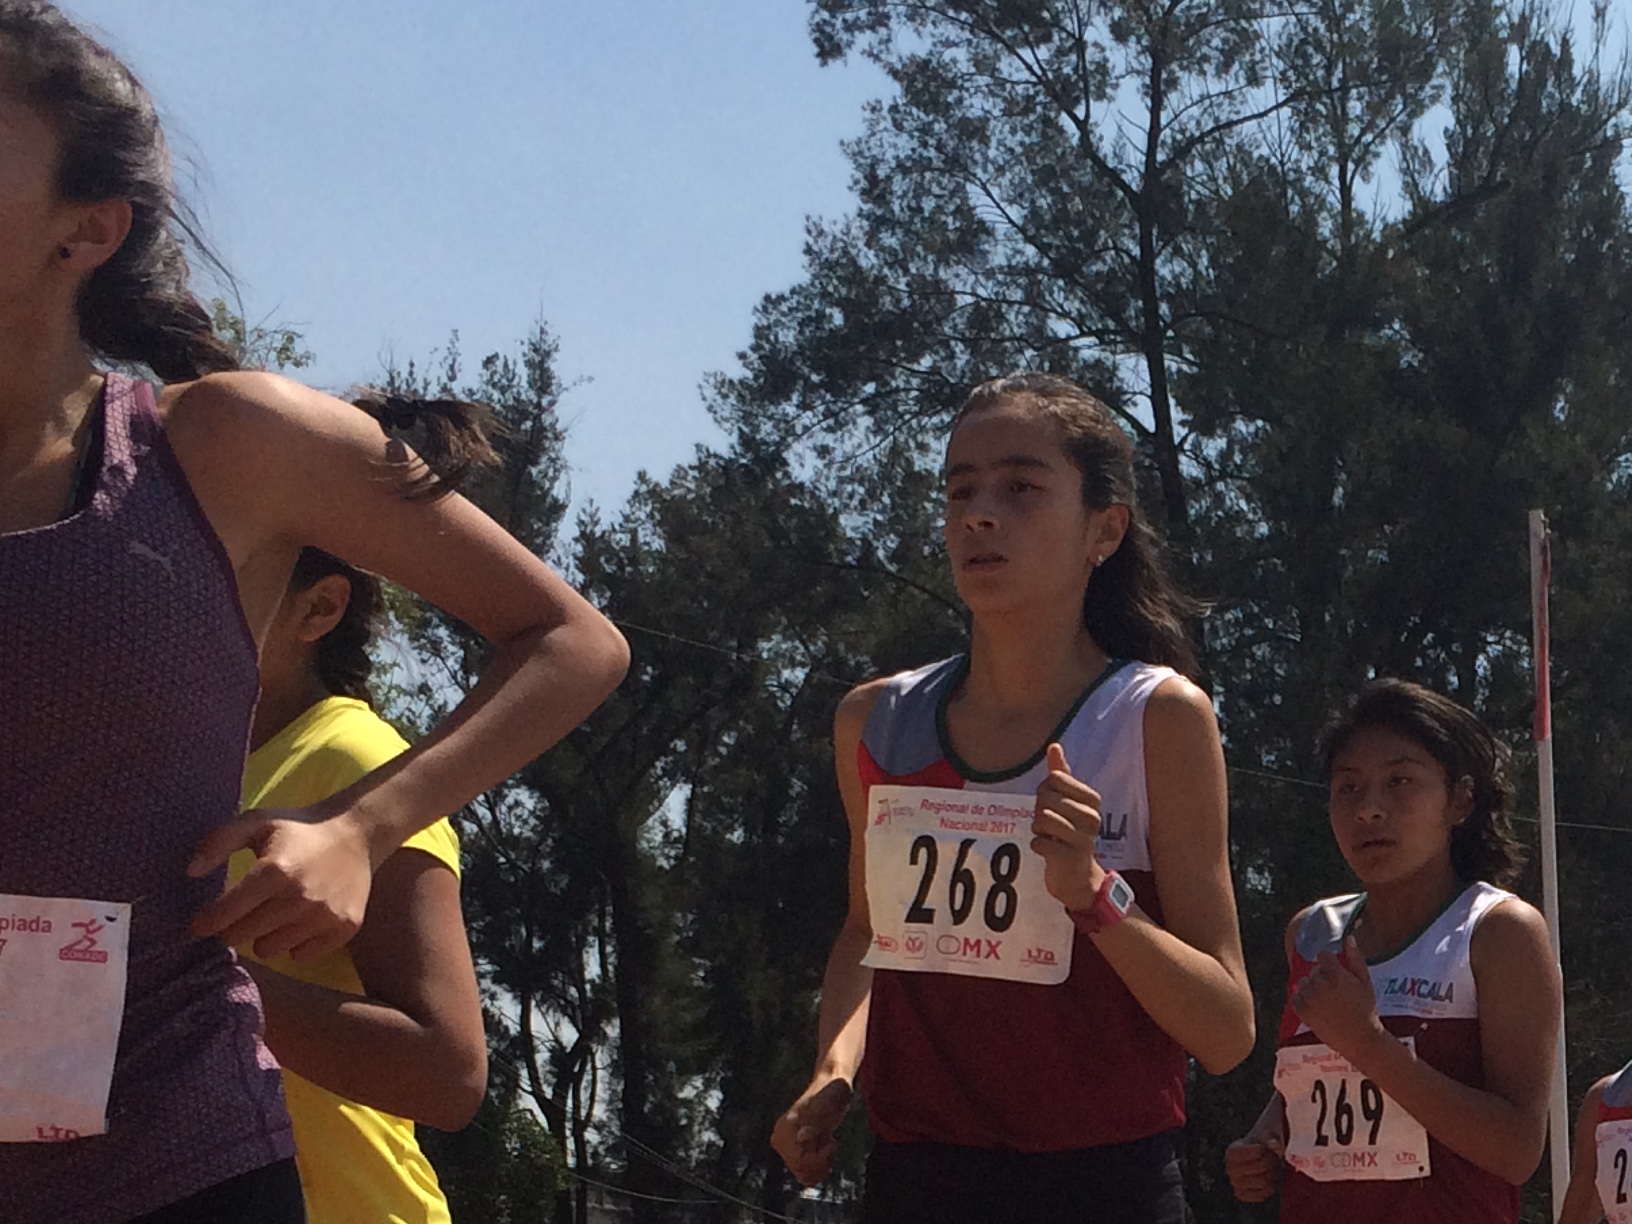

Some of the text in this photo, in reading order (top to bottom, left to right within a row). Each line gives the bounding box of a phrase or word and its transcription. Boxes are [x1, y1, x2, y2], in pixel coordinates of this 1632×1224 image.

[904, 834, 1021, 933] 268
[1384, 976, 1454, 1004] TLAXCALA
[1311, 1078, 1384, 1147] 269
[1331, 1151, 1378, 1168] CDMX
